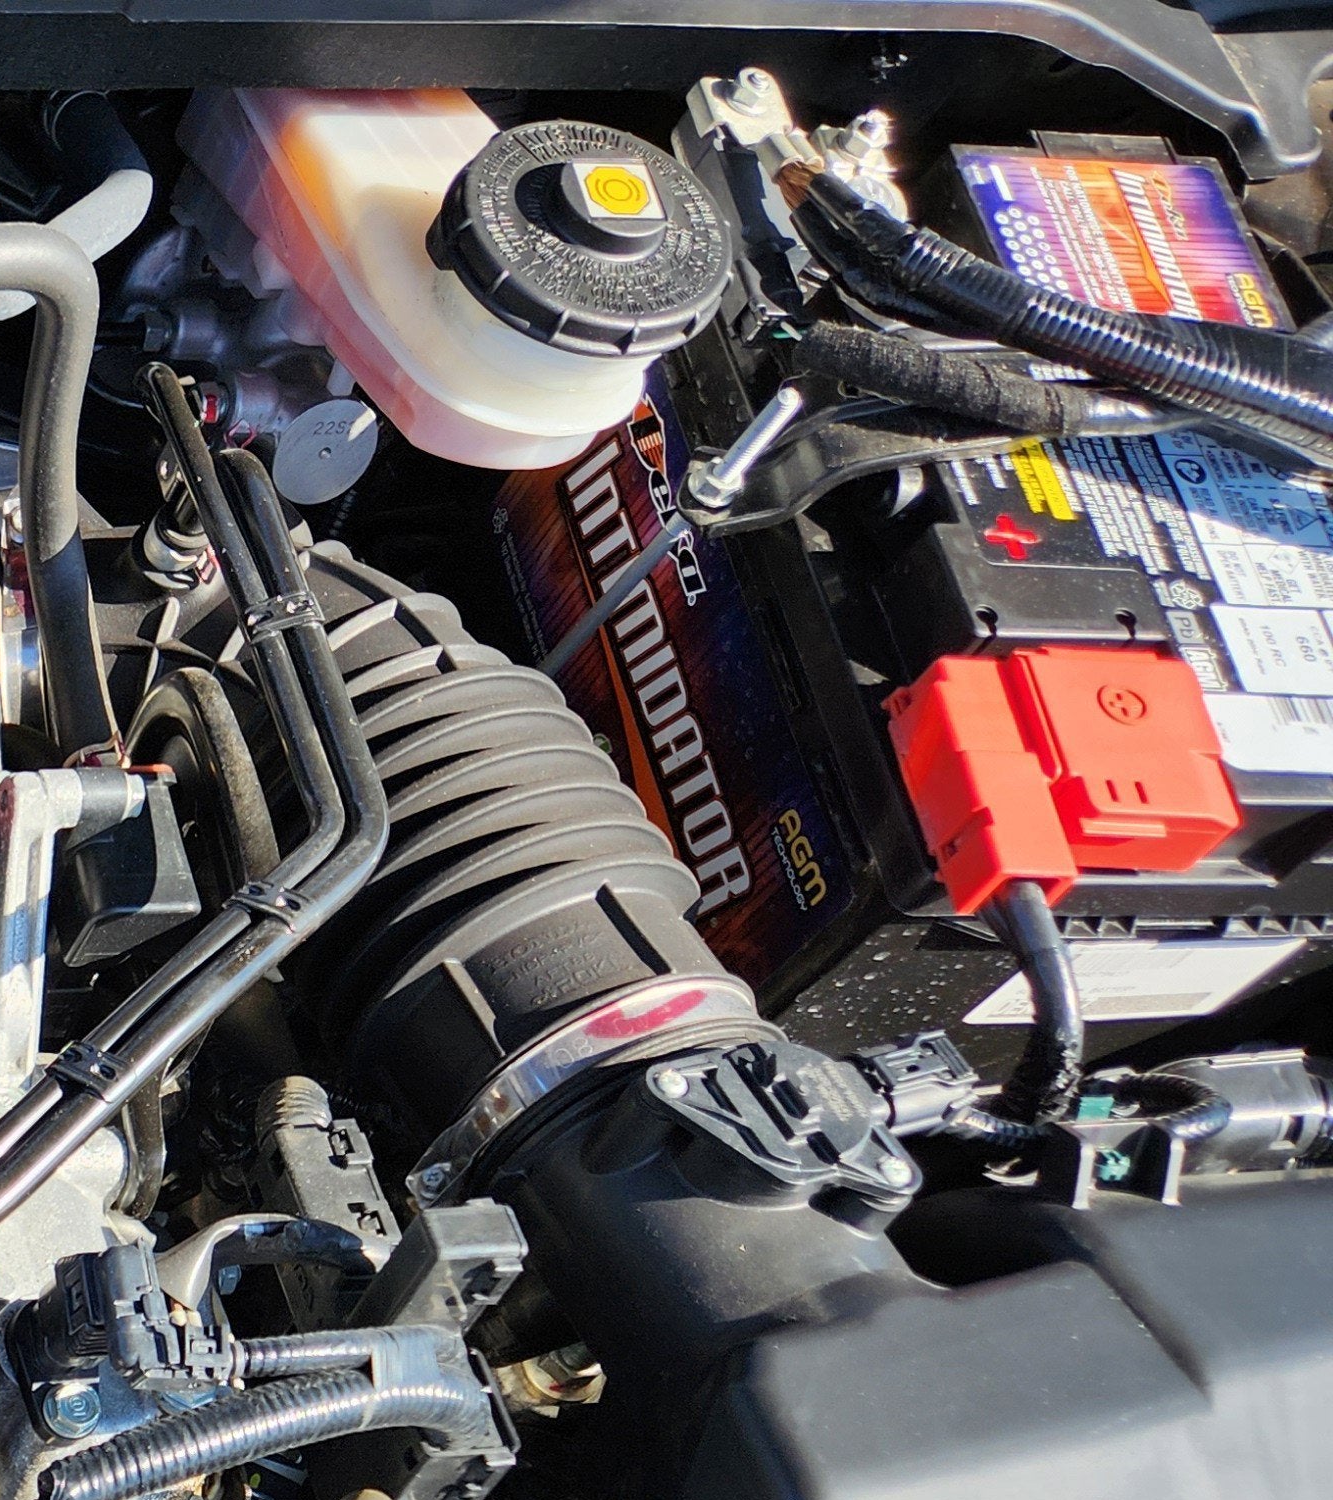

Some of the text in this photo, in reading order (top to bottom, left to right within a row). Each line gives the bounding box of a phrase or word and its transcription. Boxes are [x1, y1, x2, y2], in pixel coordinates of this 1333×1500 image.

[1233, 272, 1275, 329] AGM
[627, 393, 708, 606] Dea
[1285, 578, 1302, 593] GET
[1174, 616, 1196, 640] Pb
[1258, 625, 1287, 667] 100 RC
[1294, 635, 1318, 662] 660
[771, 827, 808, 911] TECHNOLOGY
[778, 809, 827, 907] AGM
